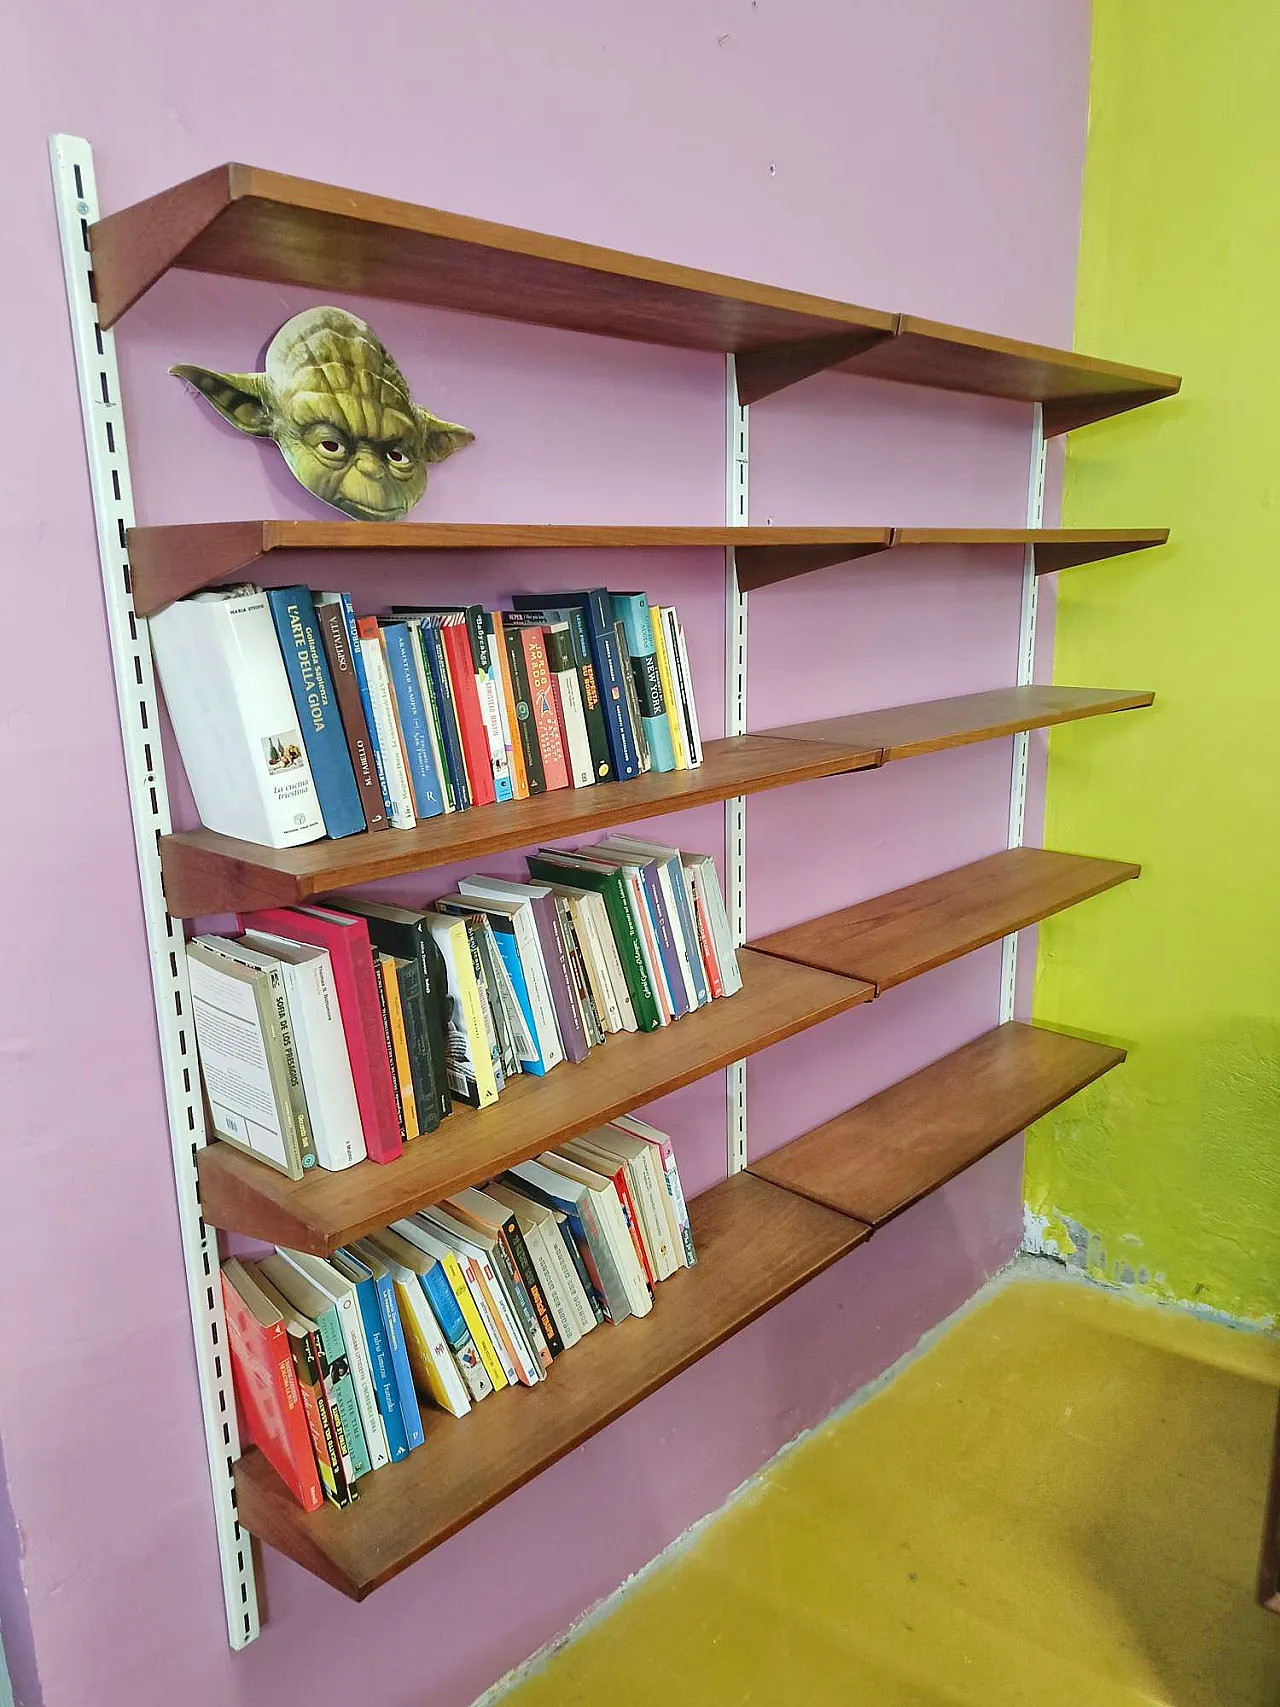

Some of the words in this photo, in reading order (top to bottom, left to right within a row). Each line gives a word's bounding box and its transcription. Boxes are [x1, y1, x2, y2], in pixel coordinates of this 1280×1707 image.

[287, 604, 305, 647] L'ARTE
[297, 649, 315, 690] DELLA
[307, 692, 325, 732] GIOIA
[304, 626, 319, 664] Goliarda
[313, 665, 328, 705] Sapienza
[527, 643, 541, 687] AMADO
[645, 656, 656, 682] NEW
[649, 683, 661, 714] YORK
[278, 787, 308, 800] triestina
[285, 780, 308, 791] cucina
[275, 996, 286, 1019] SOFIA
[280, 1020, 288, 1030] DE
[281, 1031, 290, 1046] LOS
[285, 1047, 298, 1086] PRESAGIOS
[372, 1332, 383, 1352] Fulvio
[318, 1398, 329, 1428] PASSATO
[346, 1399, 354, 1415] THE
[350, 1418, 360, 1439] TIME
